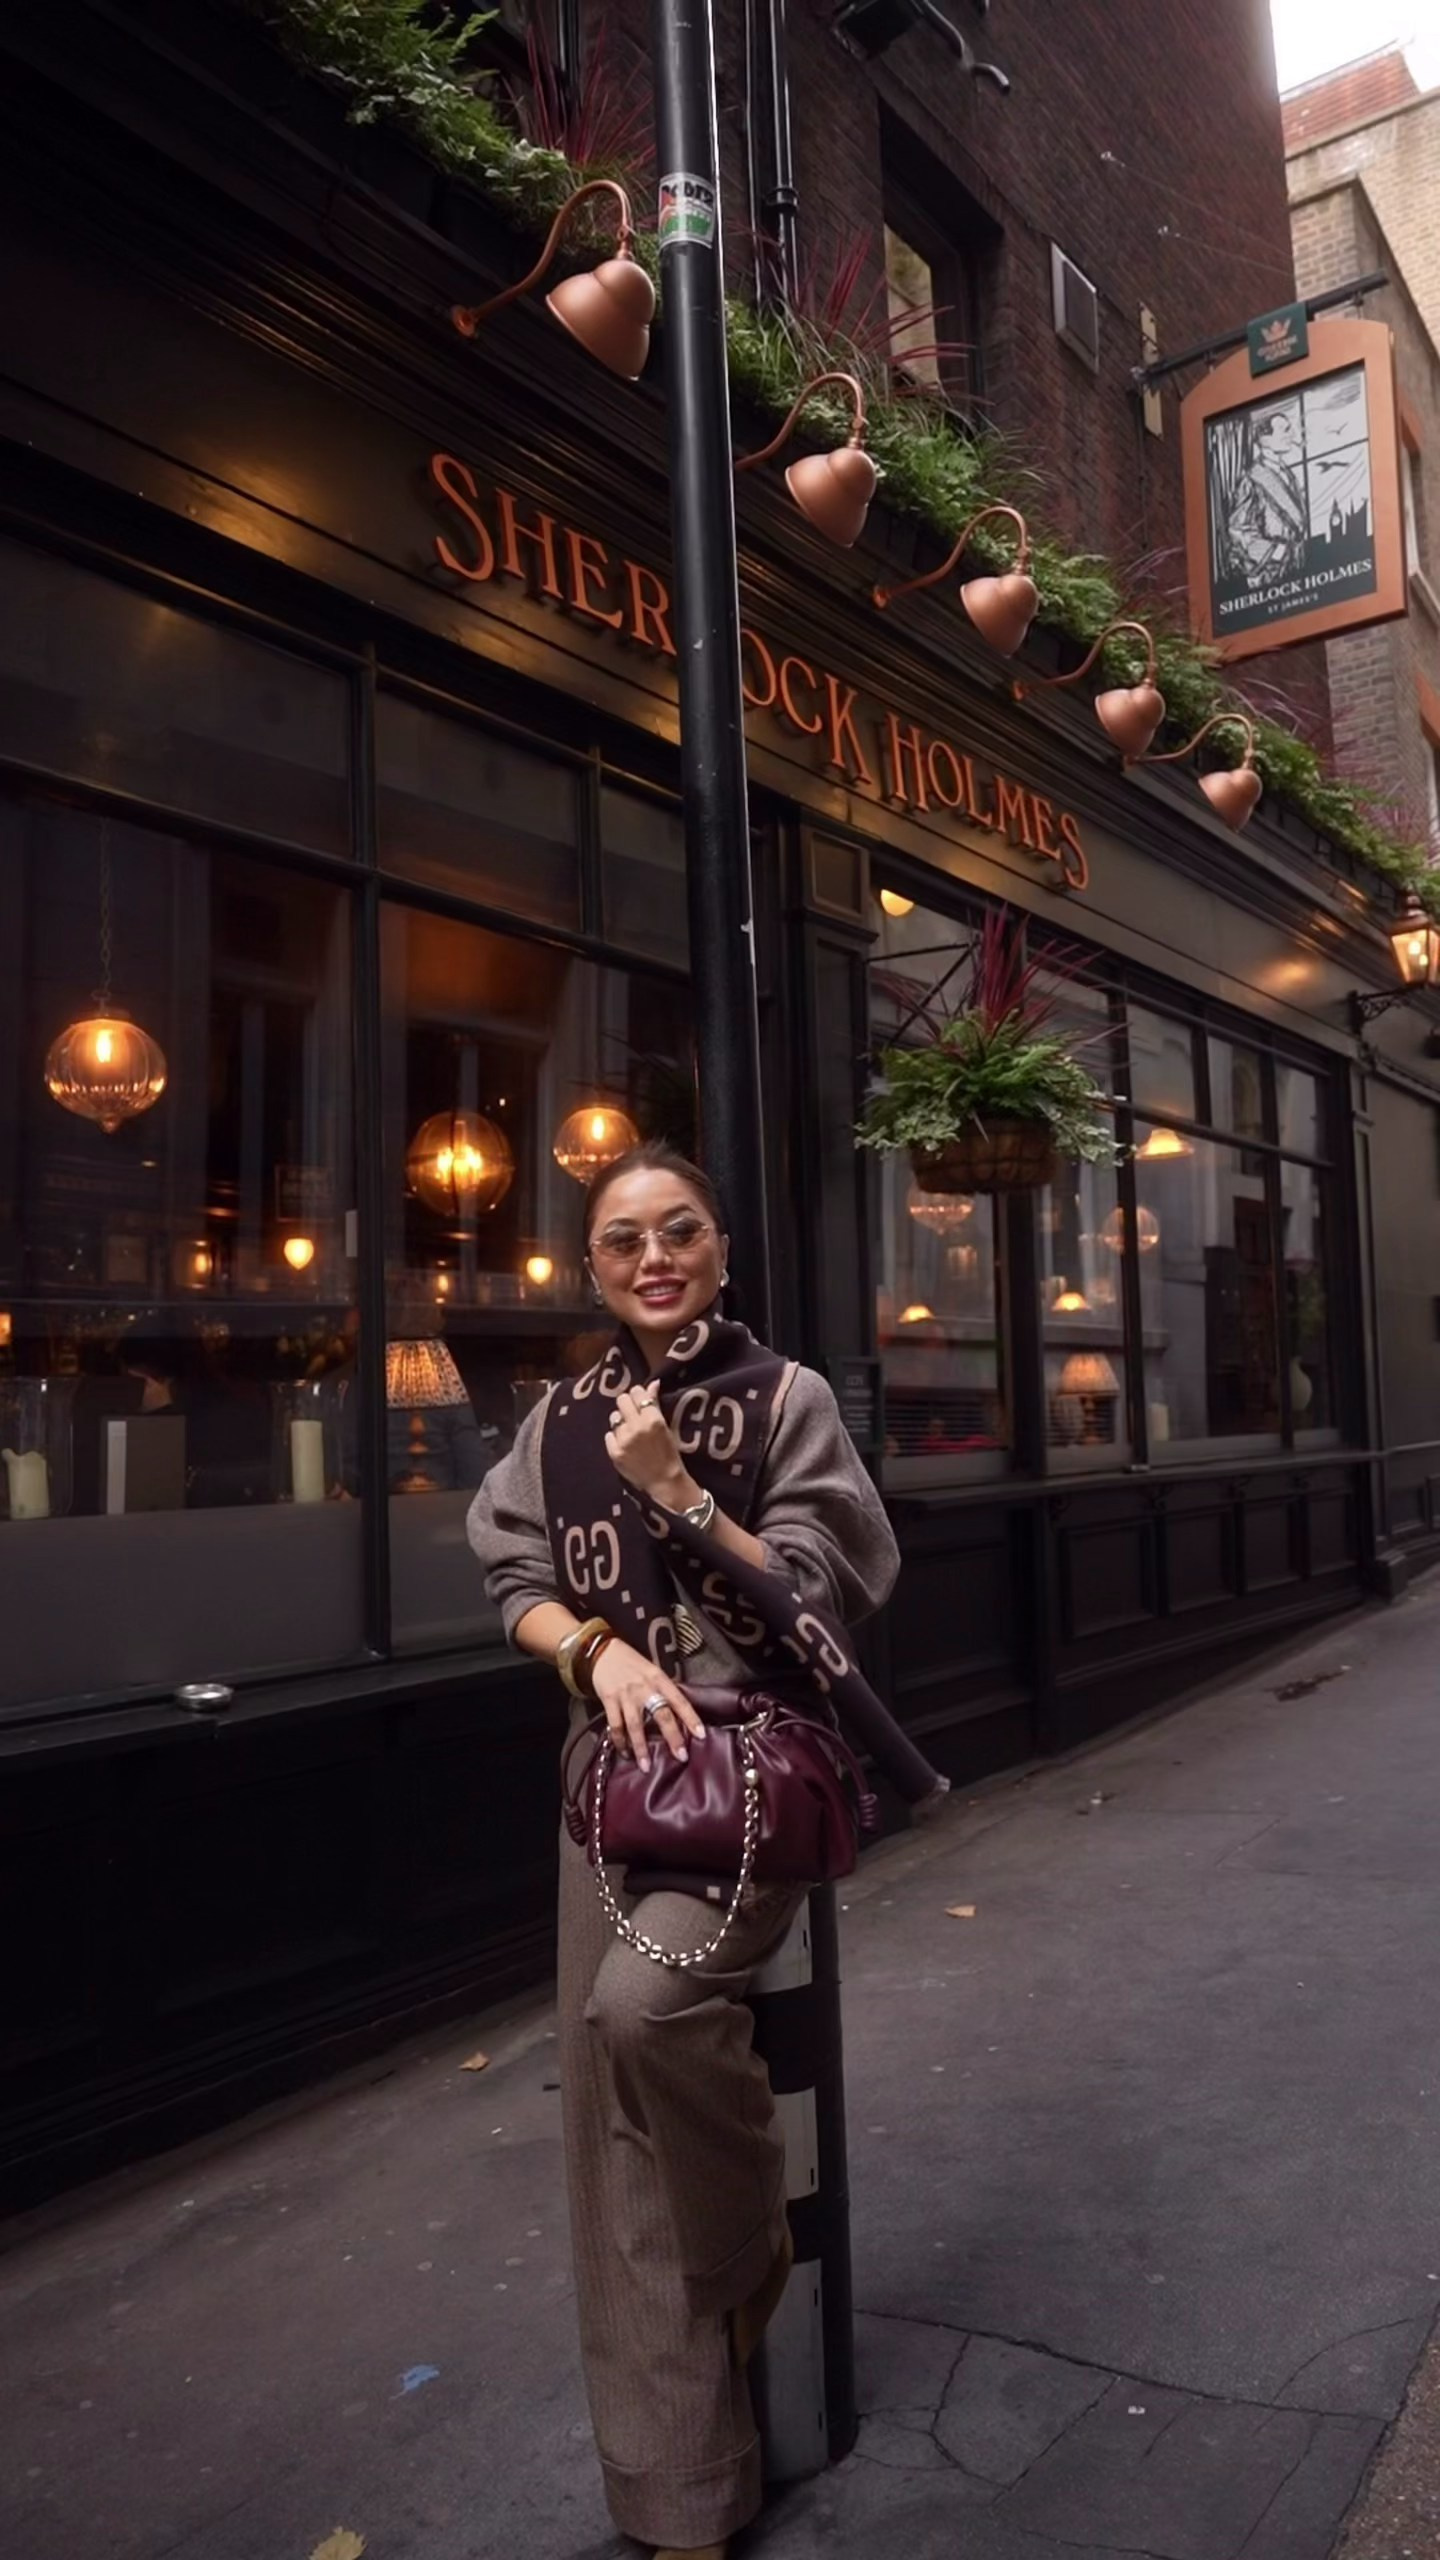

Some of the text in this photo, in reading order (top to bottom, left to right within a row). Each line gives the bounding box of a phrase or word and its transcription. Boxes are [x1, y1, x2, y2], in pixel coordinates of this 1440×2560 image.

[431, 453, 1088, 891] SHEROCK HOLMES
[1219, 558, 1372, 615] SHERLOCK HOLMES
